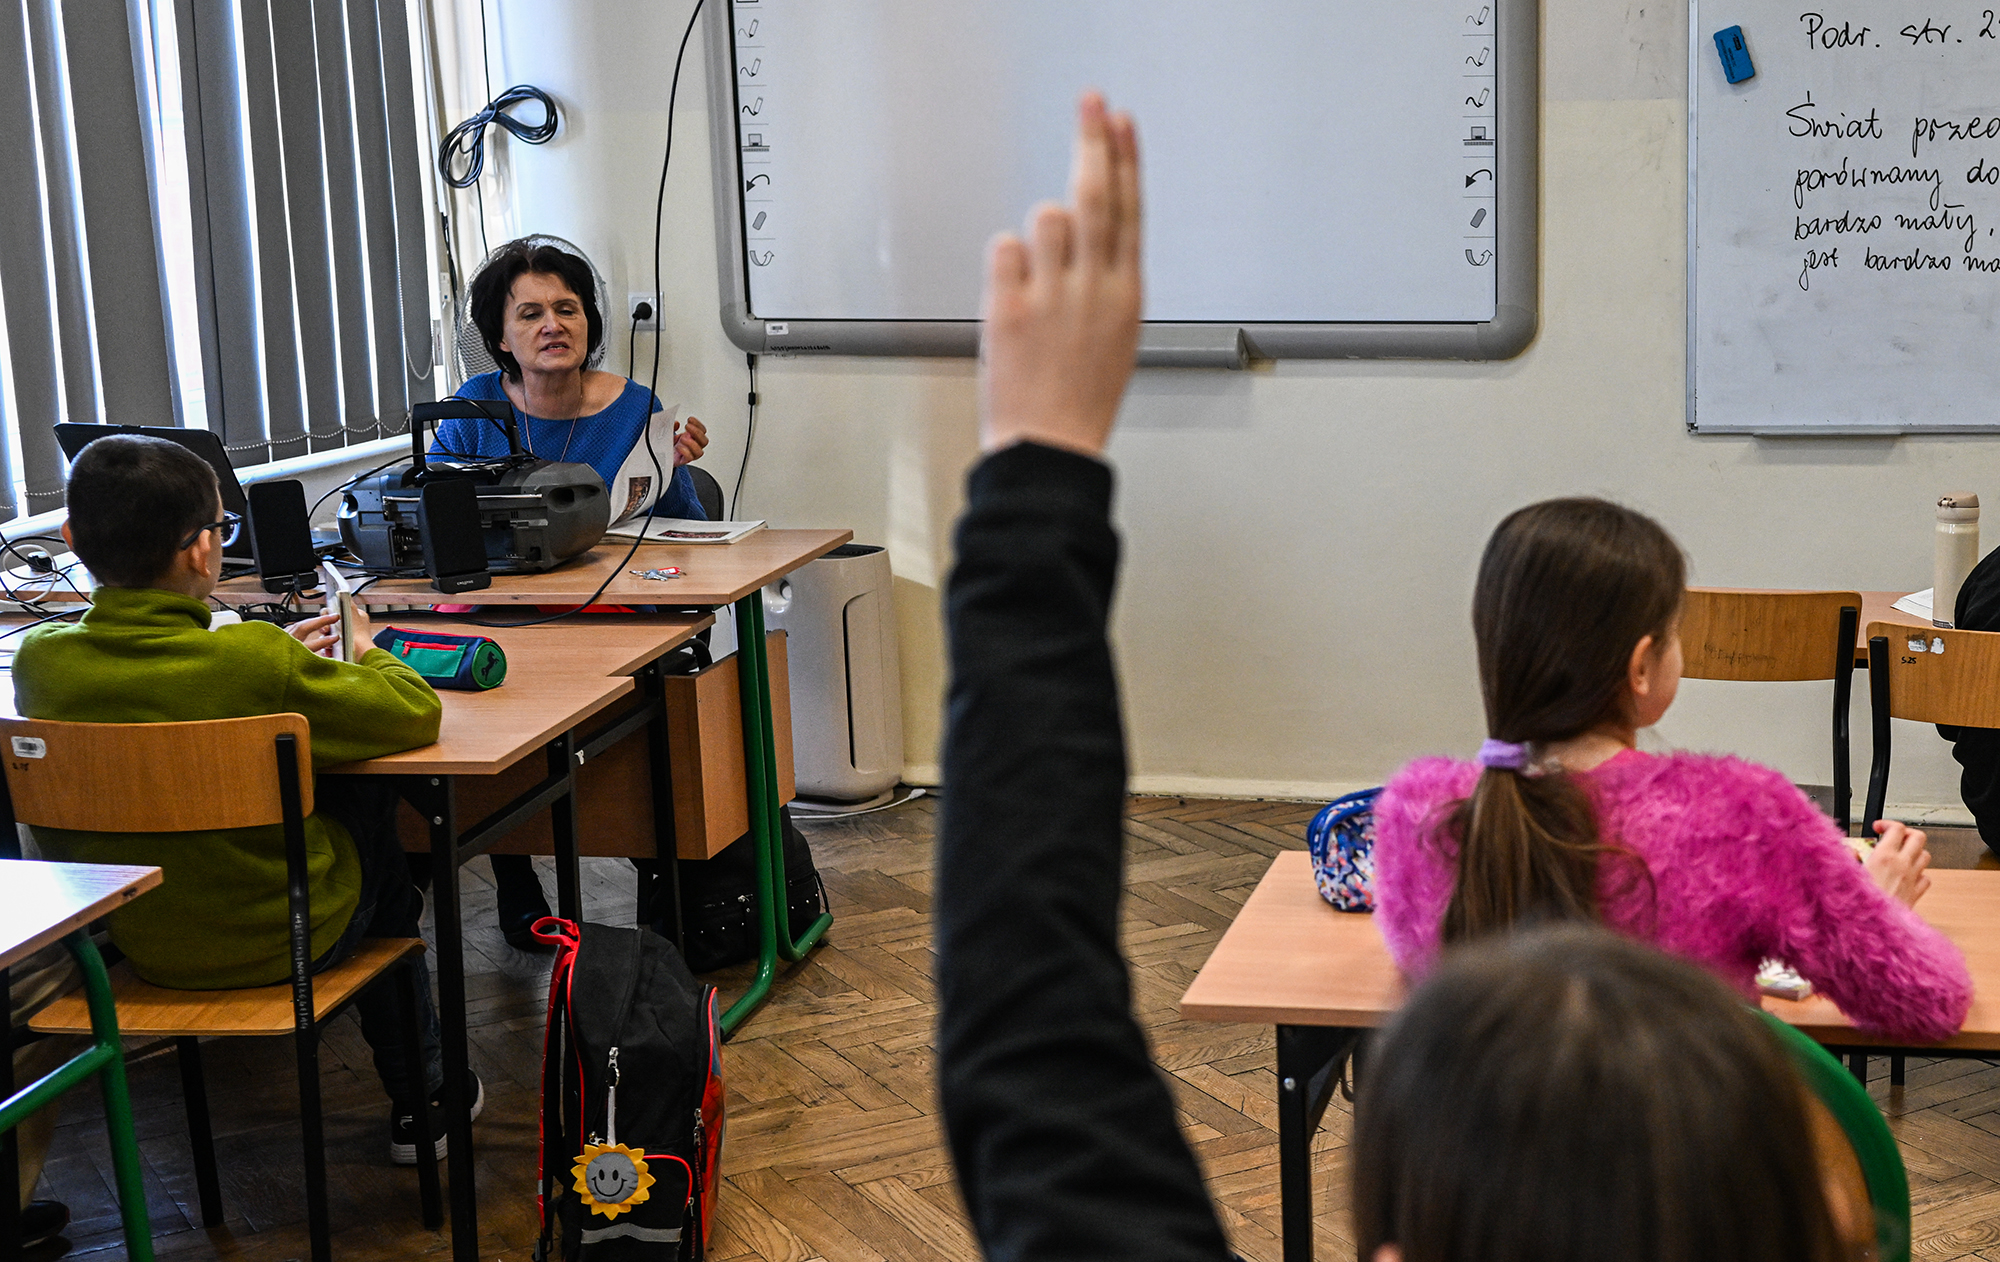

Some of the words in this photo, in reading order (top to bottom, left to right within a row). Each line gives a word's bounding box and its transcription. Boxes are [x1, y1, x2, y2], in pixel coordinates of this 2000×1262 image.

[1799, 12, 1881, 50] Podr.
[1899, 17, 1962, 46] str.
[1978, 9, 2000, 40] 2
[1785, 90, 1883, 140] Świat
[1793, 156, 1943, 212] porównany
[1966, 157, 2000, 185] do
[1794, 210, 1882, 241] bardzo
[1798, 247, 1839, 292] jest
[1864, 246, 1951, 272] bardzo
